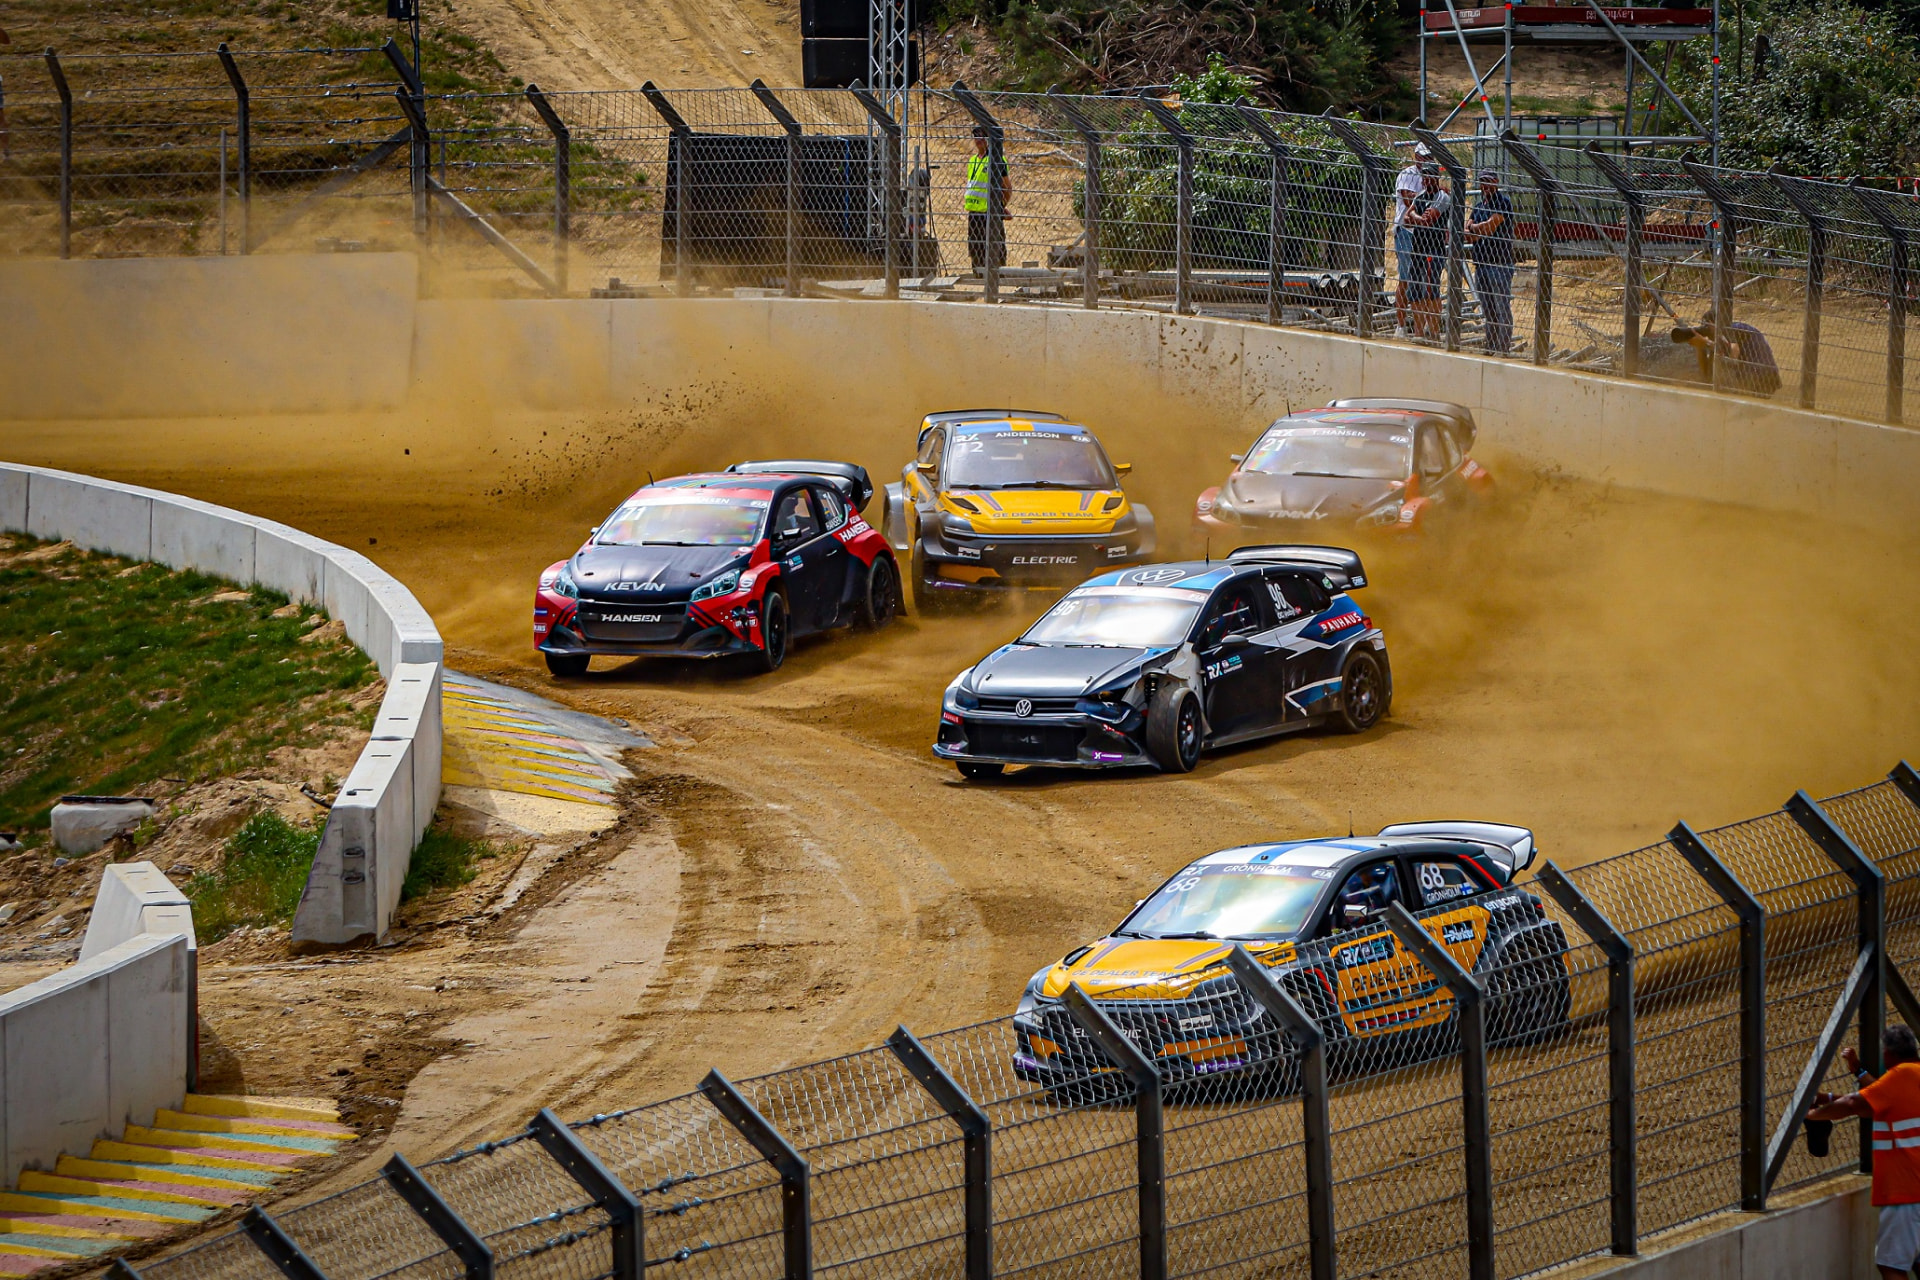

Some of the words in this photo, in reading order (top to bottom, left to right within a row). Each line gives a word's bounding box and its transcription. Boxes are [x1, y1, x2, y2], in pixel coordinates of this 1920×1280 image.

[1602, 9, 1634, 20] Layhe
[995, 431, 1060, 439] ANDERSSON
[1259, 438, 1287, 451] 21
[838, 520, 870, 542] HANSEN
[1012, 556, 1078, 565] ELECTRIC
[603, 581, 666, 592] KEVIN
[1268, 582, 1287, 610] 96
[1052, 601, 1081, 615] 96
[601, 613, 662, 624] HANSEN
[1319, 612, 1362, 634] BAUHAUS
[1421, 863, 1446, 890] 68
[1164, 876, 1201, 893] 68
